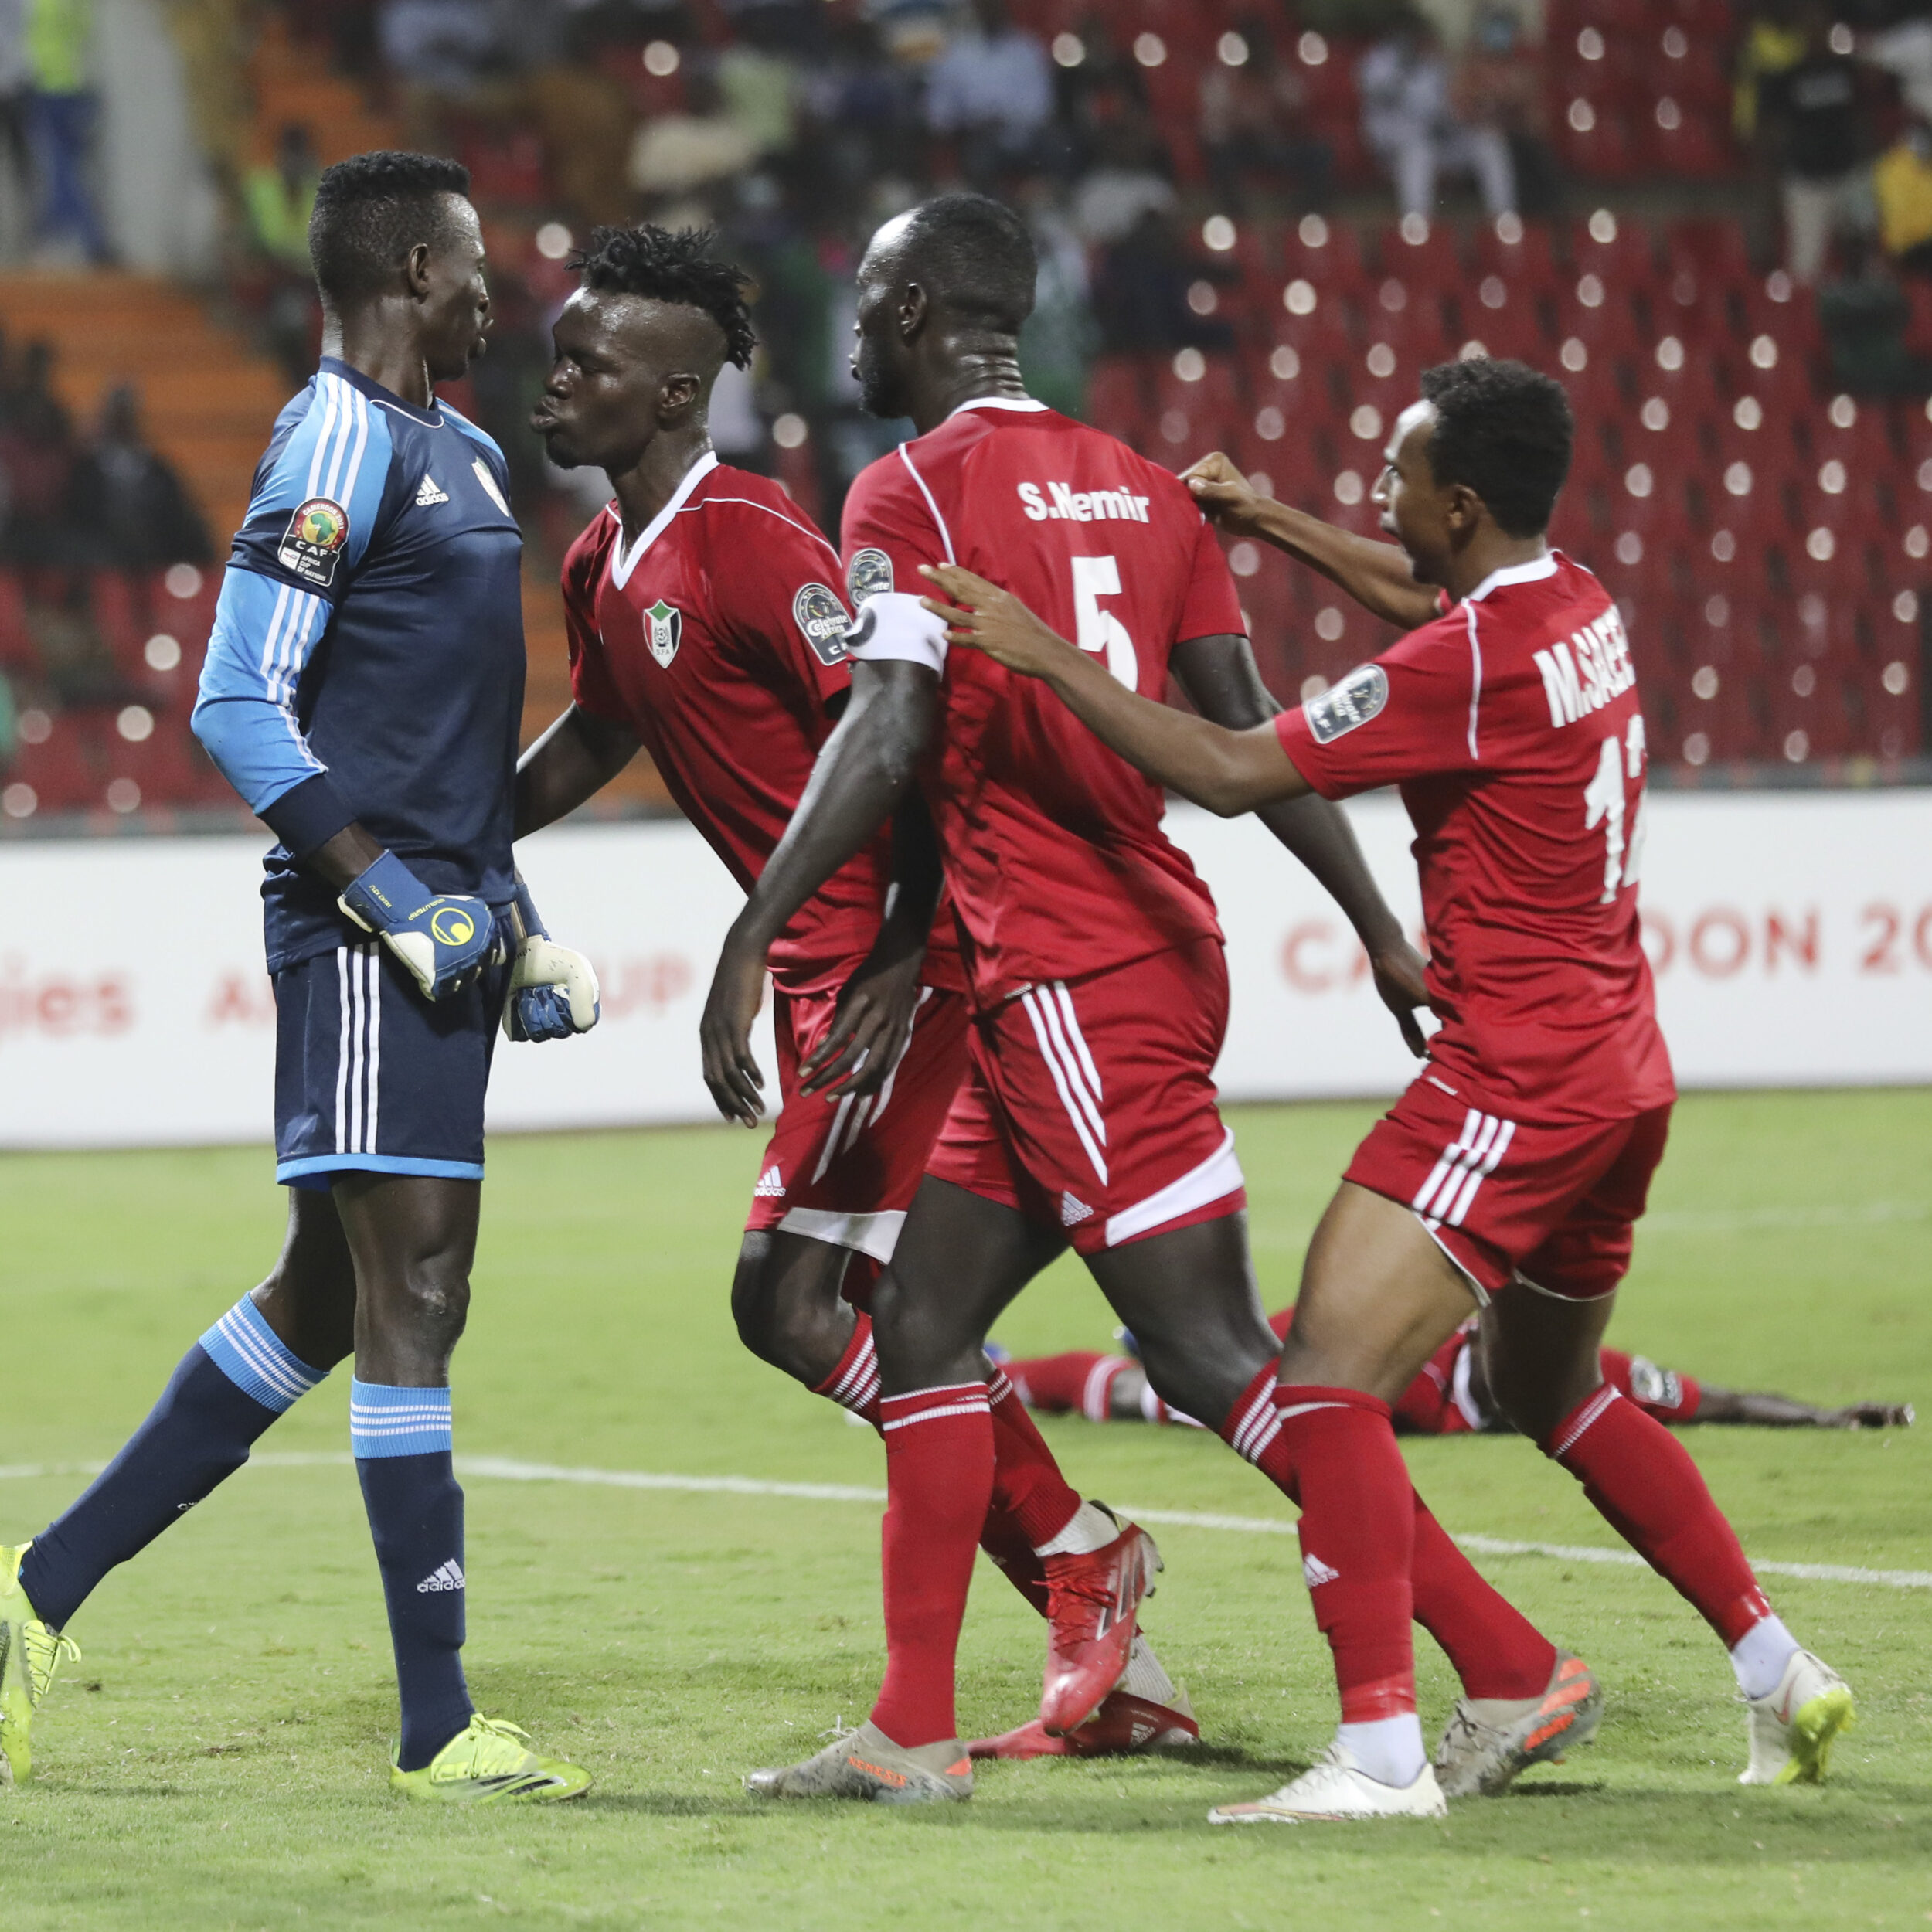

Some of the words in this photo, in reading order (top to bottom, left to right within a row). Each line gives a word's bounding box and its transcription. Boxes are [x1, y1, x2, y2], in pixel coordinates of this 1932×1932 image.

[416, 492, 449, 506] adidas
[1017, 481, 1150, 523] S.Nemir
[302, 503, 338, 515] CAMEROON
[295, 540, 328, 556] CAF
[301, 555, 321, 566] AFRICA
[304, 569, 326, 582] NATIONS
[807, 614, 849, 637] Celebrate
[1070, 555, 1138, 692] 5
[417, 1577, 465, 1593] adidas
[847, 1757, 907, 1786] NEMESIS
